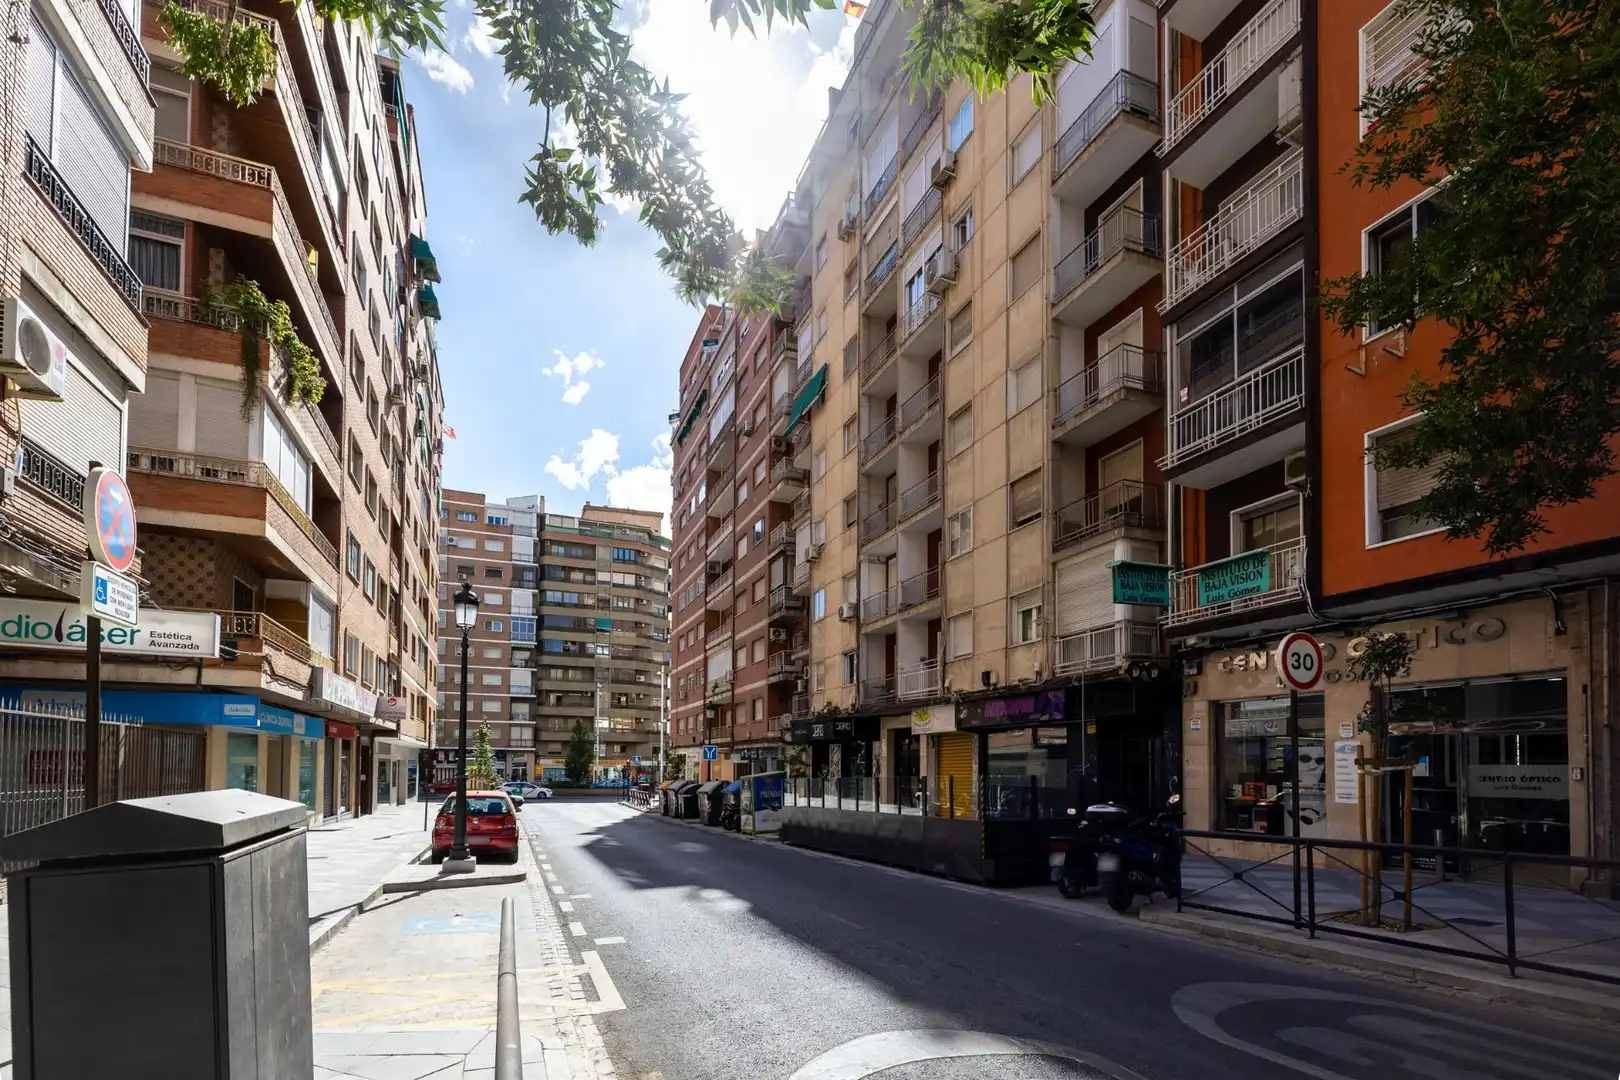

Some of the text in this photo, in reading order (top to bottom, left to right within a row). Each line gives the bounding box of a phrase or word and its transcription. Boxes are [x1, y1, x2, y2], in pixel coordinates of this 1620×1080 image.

[1201, 555, 1267, 582] INSTITUTO DE
[1120, 579, 1139, 591] BAJA
[1204, 578, 1228, 592] BAJA
[1206, 585, 1261, 603] Luis Gómez
[149, 630, 192, 641] Estética
[149, 640, 200, 650] Avanzada
[1291, 651, 1314, 671] 30
